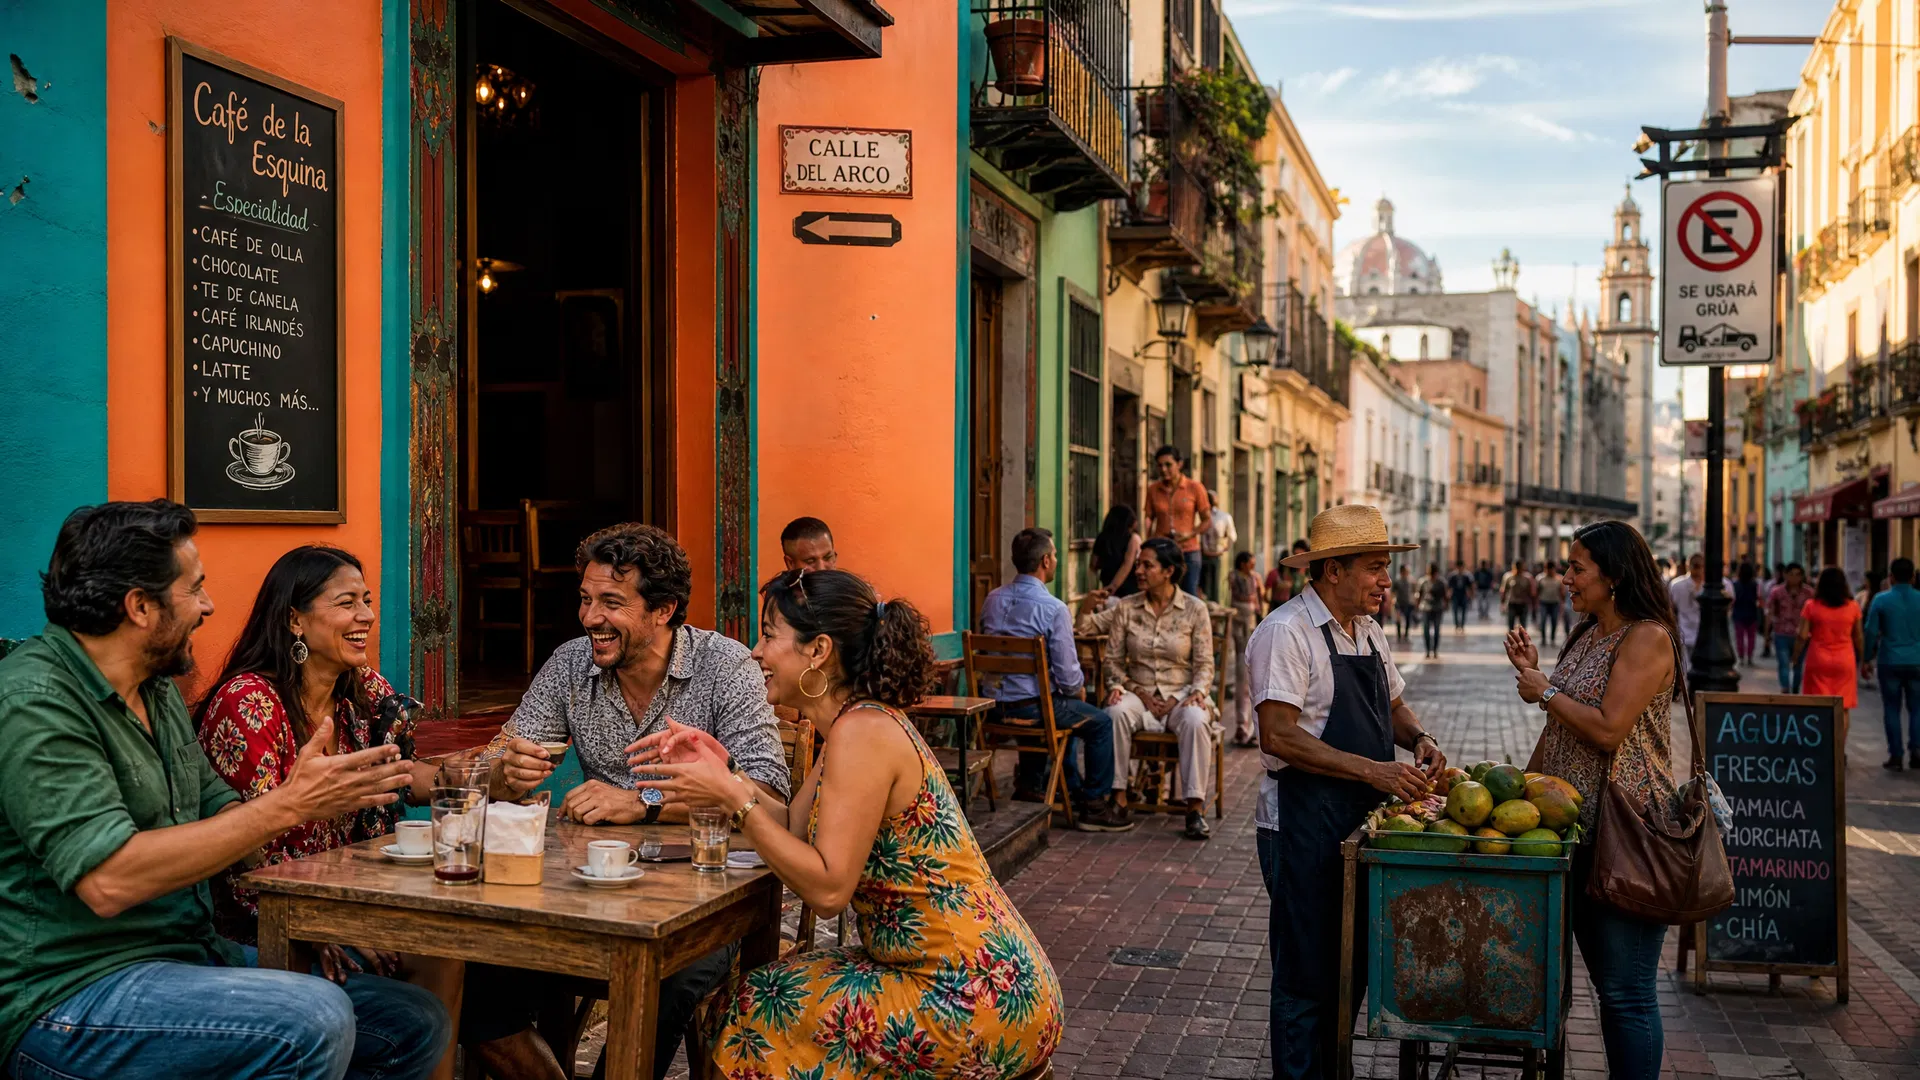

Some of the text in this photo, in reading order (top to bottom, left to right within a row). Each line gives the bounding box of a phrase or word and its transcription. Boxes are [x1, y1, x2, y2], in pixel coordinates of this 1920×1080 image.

[193, 81, 312, 148] Café de la
[809, 138, 880, 159] CALLE
[252, 140, 329, 198] Esquina
[797, 164, 890, 184] DEL ARCO
[213, 180, 310, 232] Especialidad
[200, 225, 304, 264] CAFÉ DE OLLA
[201, 254, 279, 285] CHOCOLATE
[201, 281, 300, 313] TE DE CANELA
[1679, 280, 1758, 299] SE USARÁ
[201, 307, 304, 338] CAFÉ IRLANDÉS
[1696, 300, 1739, 317] GRÚA
[201, 333, 282, 360] CAPUCHINO
[202, 360, 251, 381] LATTE
[201, 386, 320, 411] Y MUCHOS MÁS...
[1716, 711, 1823, 748] AGUAS
[1713, 755, 1817, 786] FRESCAS
[1726, 795, 1806, 820] JAMAICA
[1726, 826, 1823, 850] HORCHATA
[1728, 855, 1830, 881] TAMARINDO
[1726, 913, 1780, 942] CHÍA
